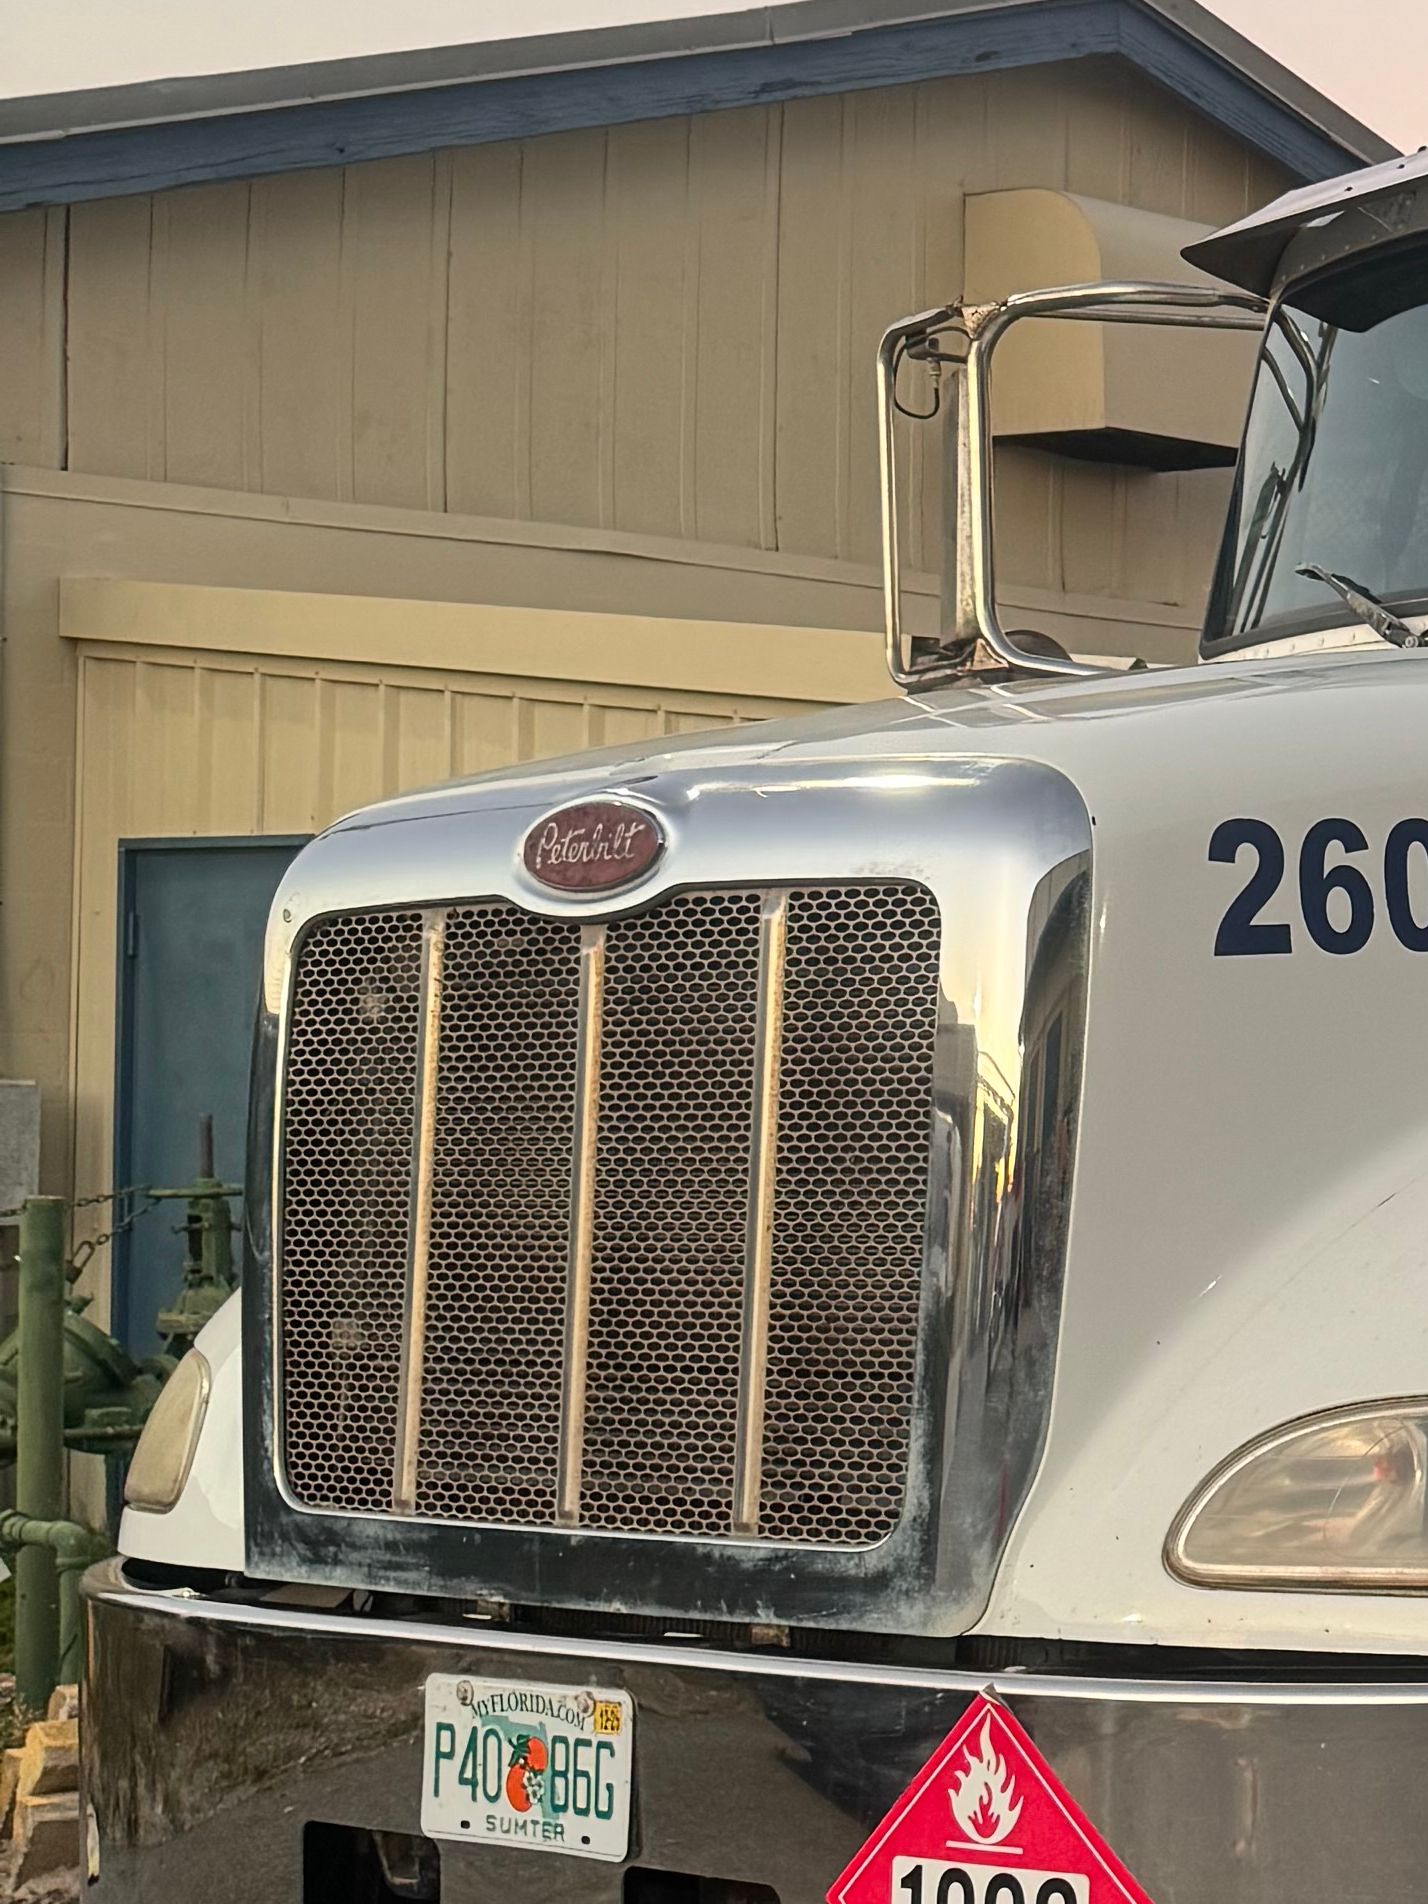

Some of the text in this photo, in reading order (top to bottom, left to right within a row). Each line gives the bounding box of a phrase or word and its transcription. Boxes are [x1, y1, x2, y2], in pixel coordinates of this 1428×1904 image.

[535, 821, 647, 870] Peterbilt
[471, 1691, 586, 1731] MYFLORIDA.COM
[433, 1721, 616, 1820] P40 86G
[485, 1814, 565, 1842] SUMTER
